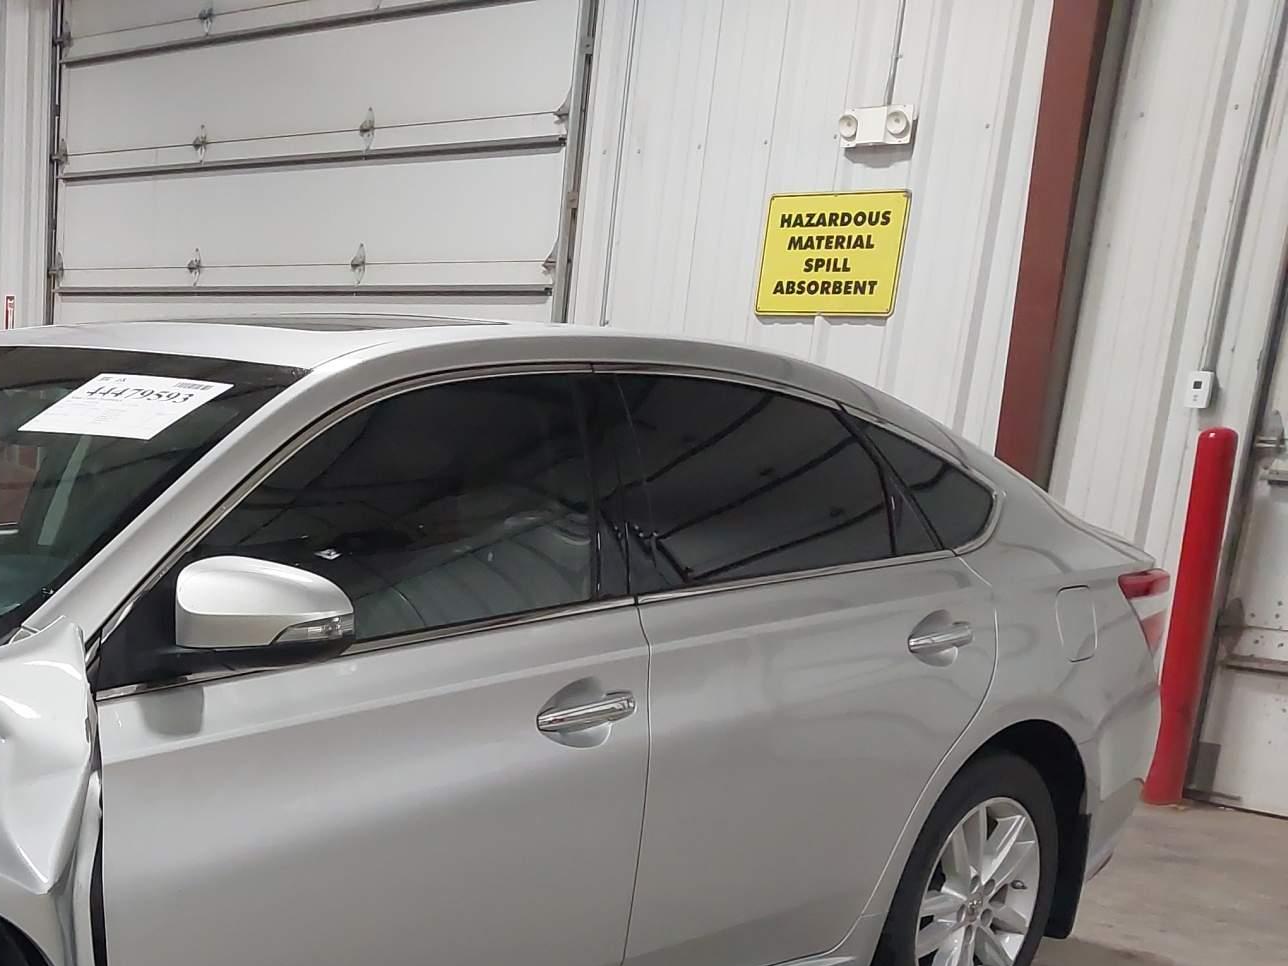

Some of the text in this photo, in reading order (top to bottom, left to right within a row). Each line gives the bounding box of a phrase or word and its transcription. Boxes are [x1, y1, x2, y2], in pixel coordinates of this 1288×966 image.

[780, 211, 891, 228] HAZARDOUS
[787, 235, 874, 250] MATERIAL
[803, 258, 851, 272] SPILL
[773, 281, 878, 295] ABSORBENT
[86, 386, 195, 404] 44479593
